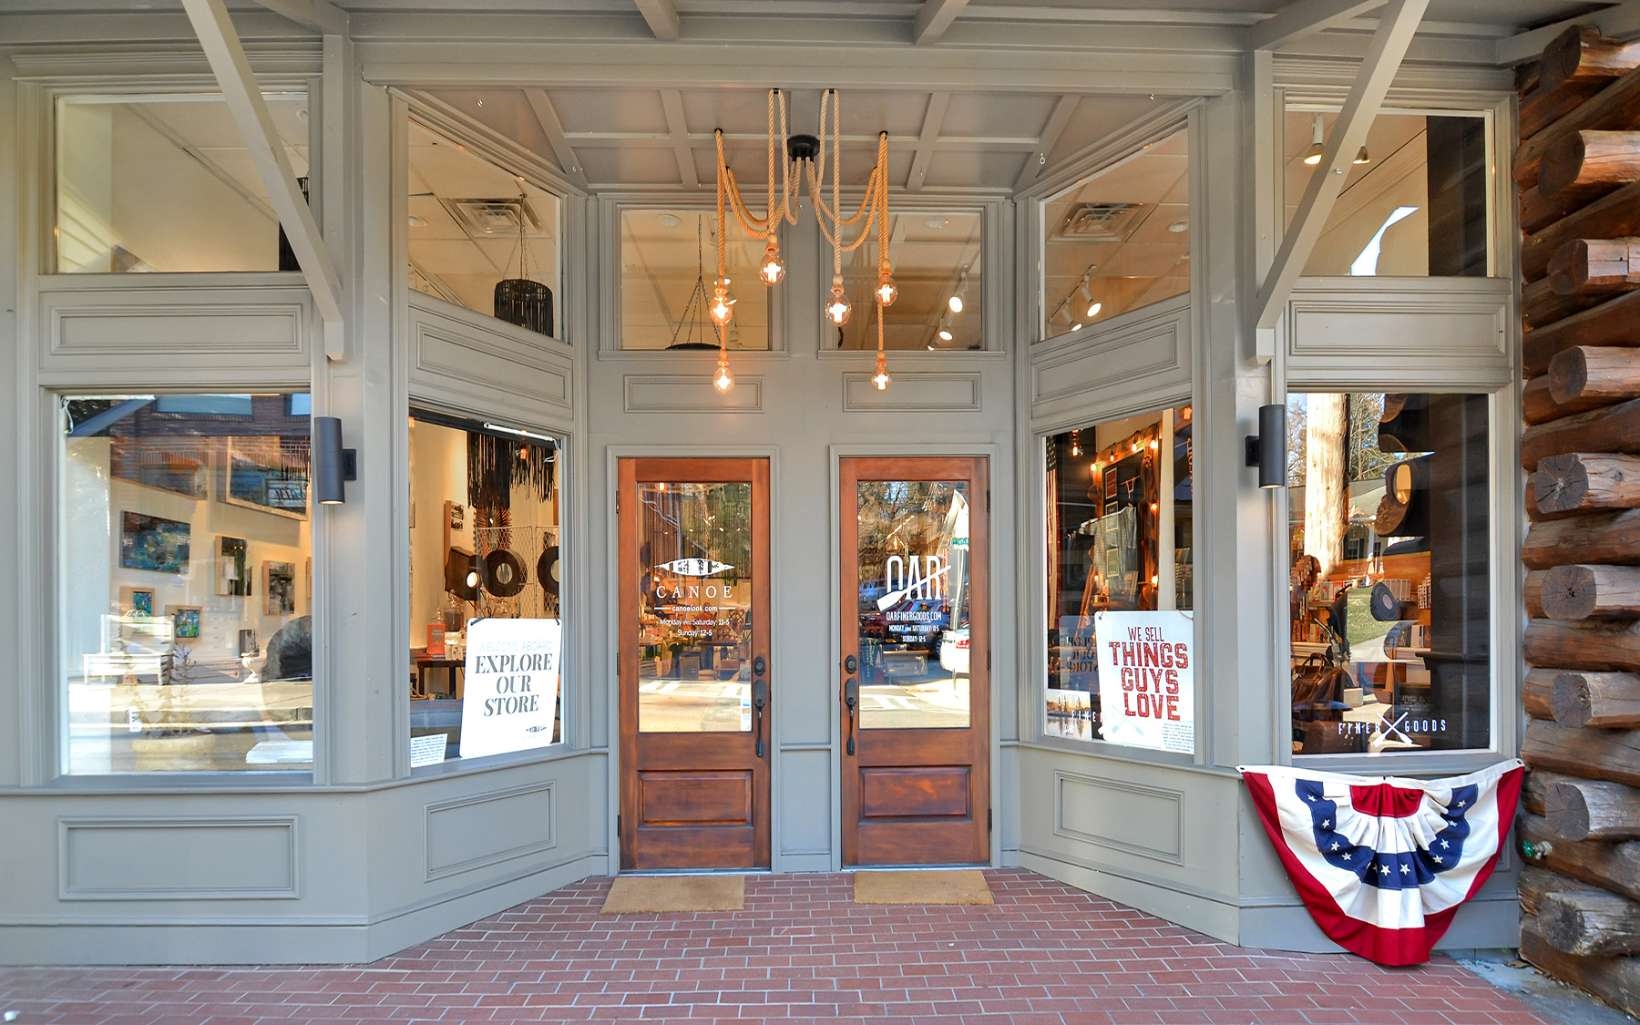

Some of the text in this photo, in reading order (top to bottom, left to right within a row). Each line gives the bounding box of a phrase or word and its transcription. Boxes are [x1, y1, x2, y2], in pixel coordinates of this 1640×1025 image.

[886, 555, 941, 600] OAR
[656, 585, 733, 599] CANOE
[1127, 626, 1165, 642] WE SELL
[475, 653, 553, 674] EXPLORE
[1108, 641, 1189, 669] THINGS
[496, 674, 532, 694] OUR
[1120, 667, 1179, 694] GUYS
[483, 694, 540, 717] STORE
[1123, 692, 1181, 722] LOVE
[1404, 719, 1447, 733] GOODS
